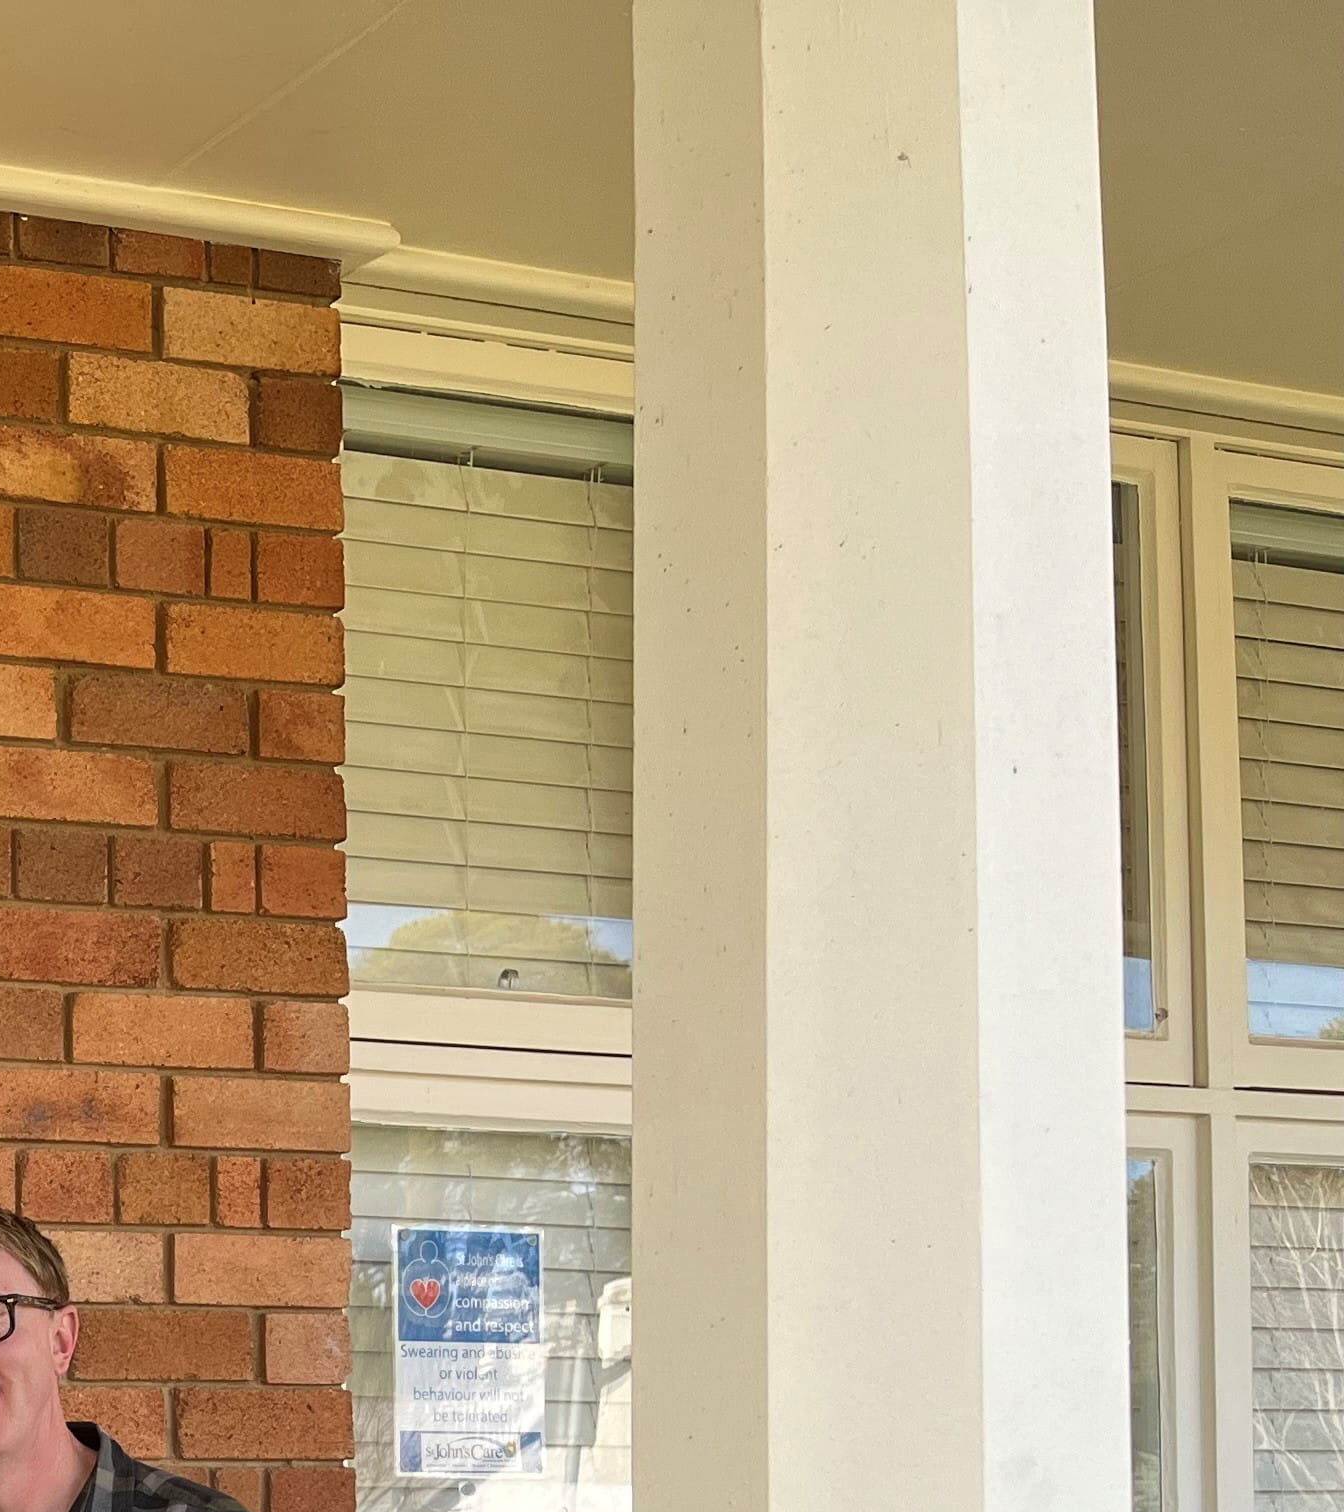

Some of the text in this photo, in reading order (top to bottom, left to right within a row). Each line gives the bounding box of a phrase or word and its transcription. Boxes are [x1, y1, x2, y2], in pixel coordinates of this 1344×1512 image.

[467, 1253, 493, 1267] John's
[455, 1297, 529, 1311] compassion
[455, 1318, 534, 1335] and respect
[400, 1344, 458, 1362] Swearing
[462, 1346, 485, 1360] and
[439, 1369, 452, 1380] or
[413, 1387, 524, 1402] behaviour will not
[433, 1408, 448, 1423] be
